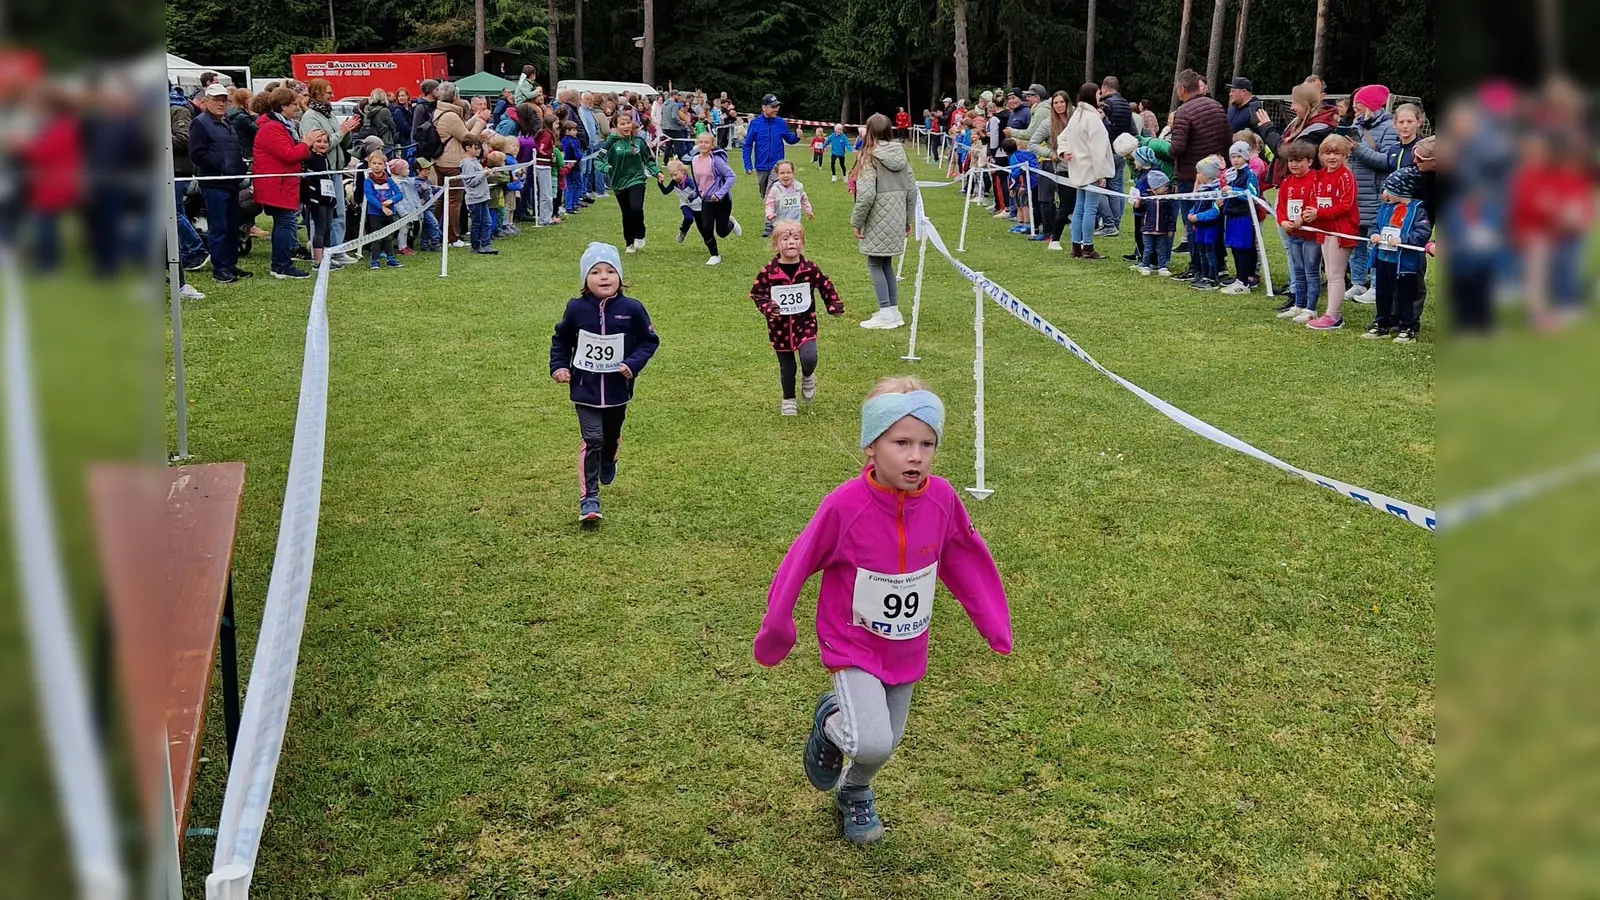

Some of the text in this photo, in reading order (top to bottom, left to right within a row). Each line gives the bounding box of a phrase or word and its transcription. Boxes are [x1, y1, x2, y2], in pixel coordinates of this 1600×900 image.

[784, 198, 797, 206] 320
[780, 292, 803, 306] 238
[585, 343, 614, 361] 239
[883, 591, 919, 619] 99
[896, 623, 911, 633] VR
